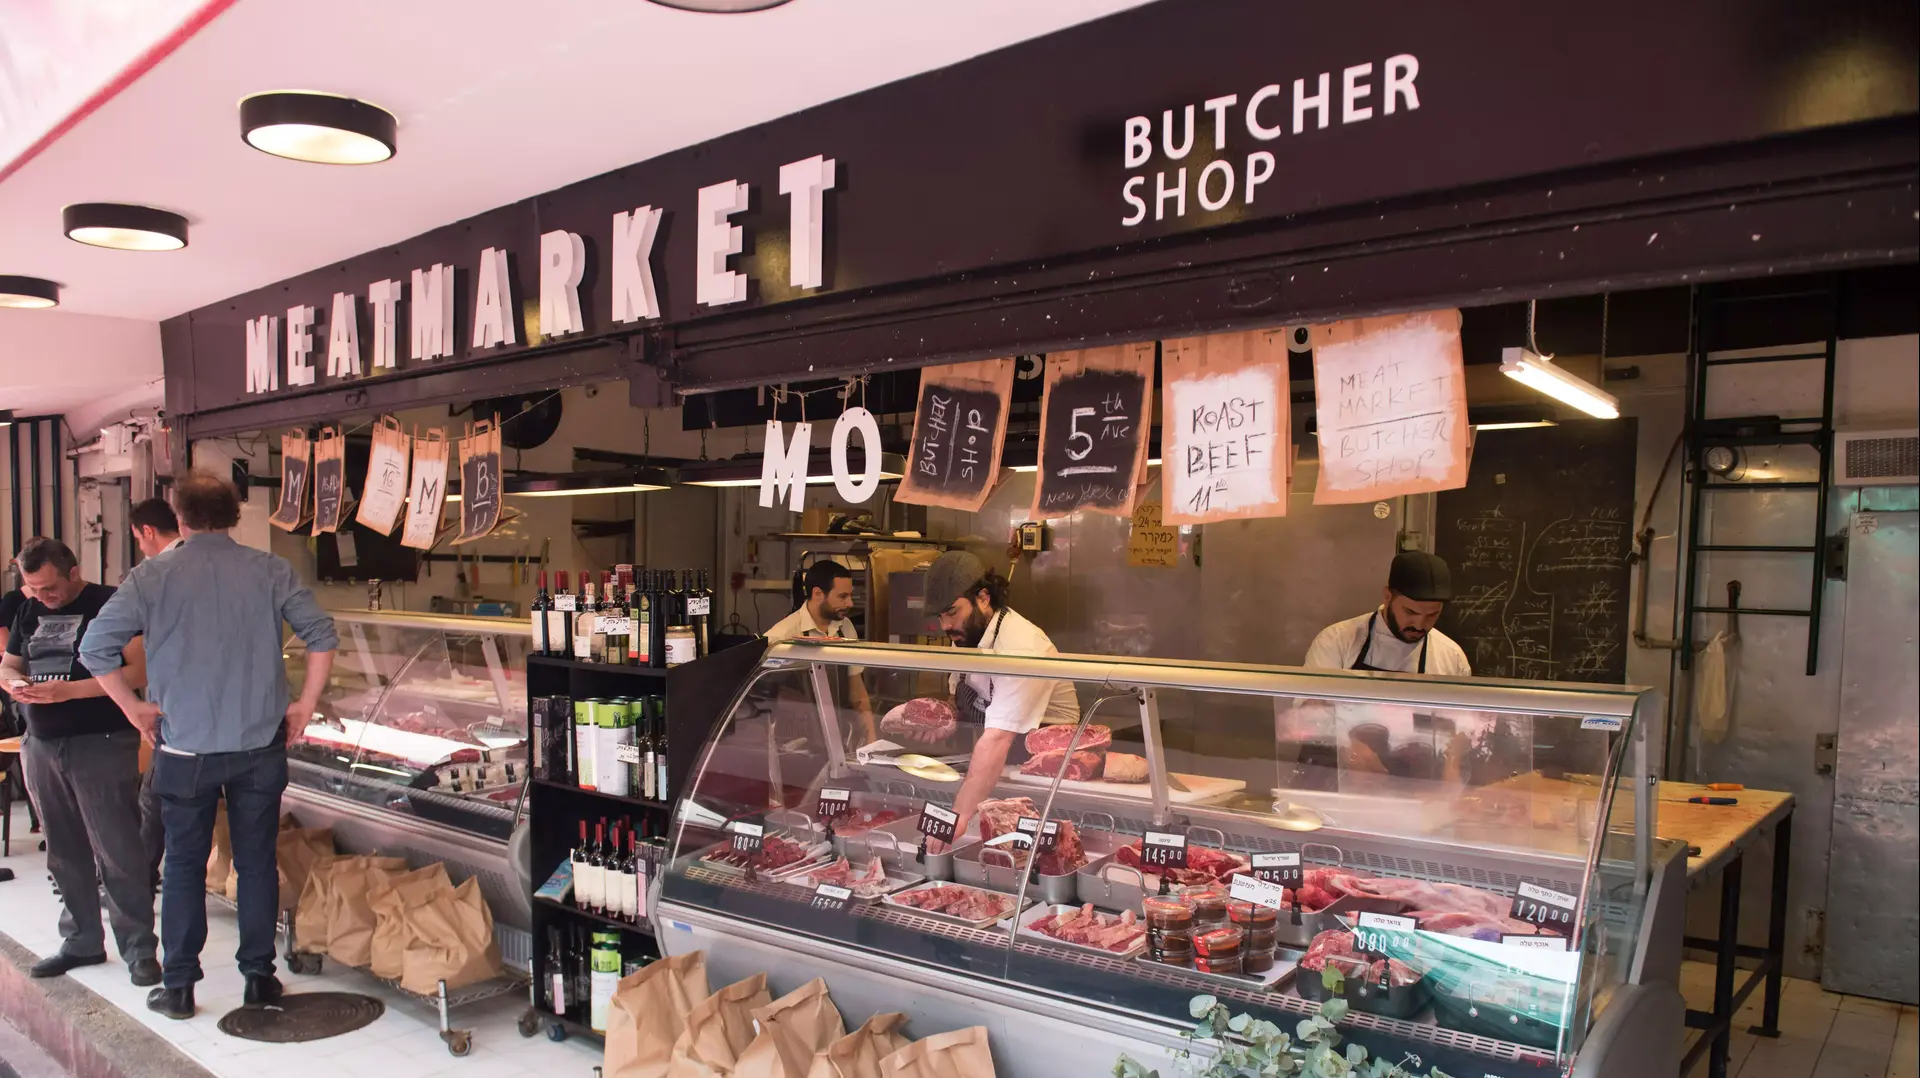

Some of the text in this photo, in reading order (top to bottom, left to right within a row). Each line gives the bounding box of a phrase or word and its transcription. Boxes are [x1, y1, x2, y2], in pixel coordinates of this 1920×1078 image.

[1124, 53, 1420, 169] BUTCHER
[1121, 151, 1276, 227] SHOP
[246, 154, 835, 394] MEATMARKET
[1338, 375, 1450, 419] MARKET
[1340, 361, 1403, 395] MEAT
[919, 394, 952, 476] BUTCHER
[1064, 407, 1097, 461] 5
[1192, 397, 1264, 435] ROAST
[1340, 416, 1449, 459] BUTCHER
[1187, 432, 1267, 478] BEEF
[1355, 449, 1435, 488] SHOP
[287, 469, 302, 506] M
[416, 476, 439, 515] M
[41, 622, 73, 633] MEAT
